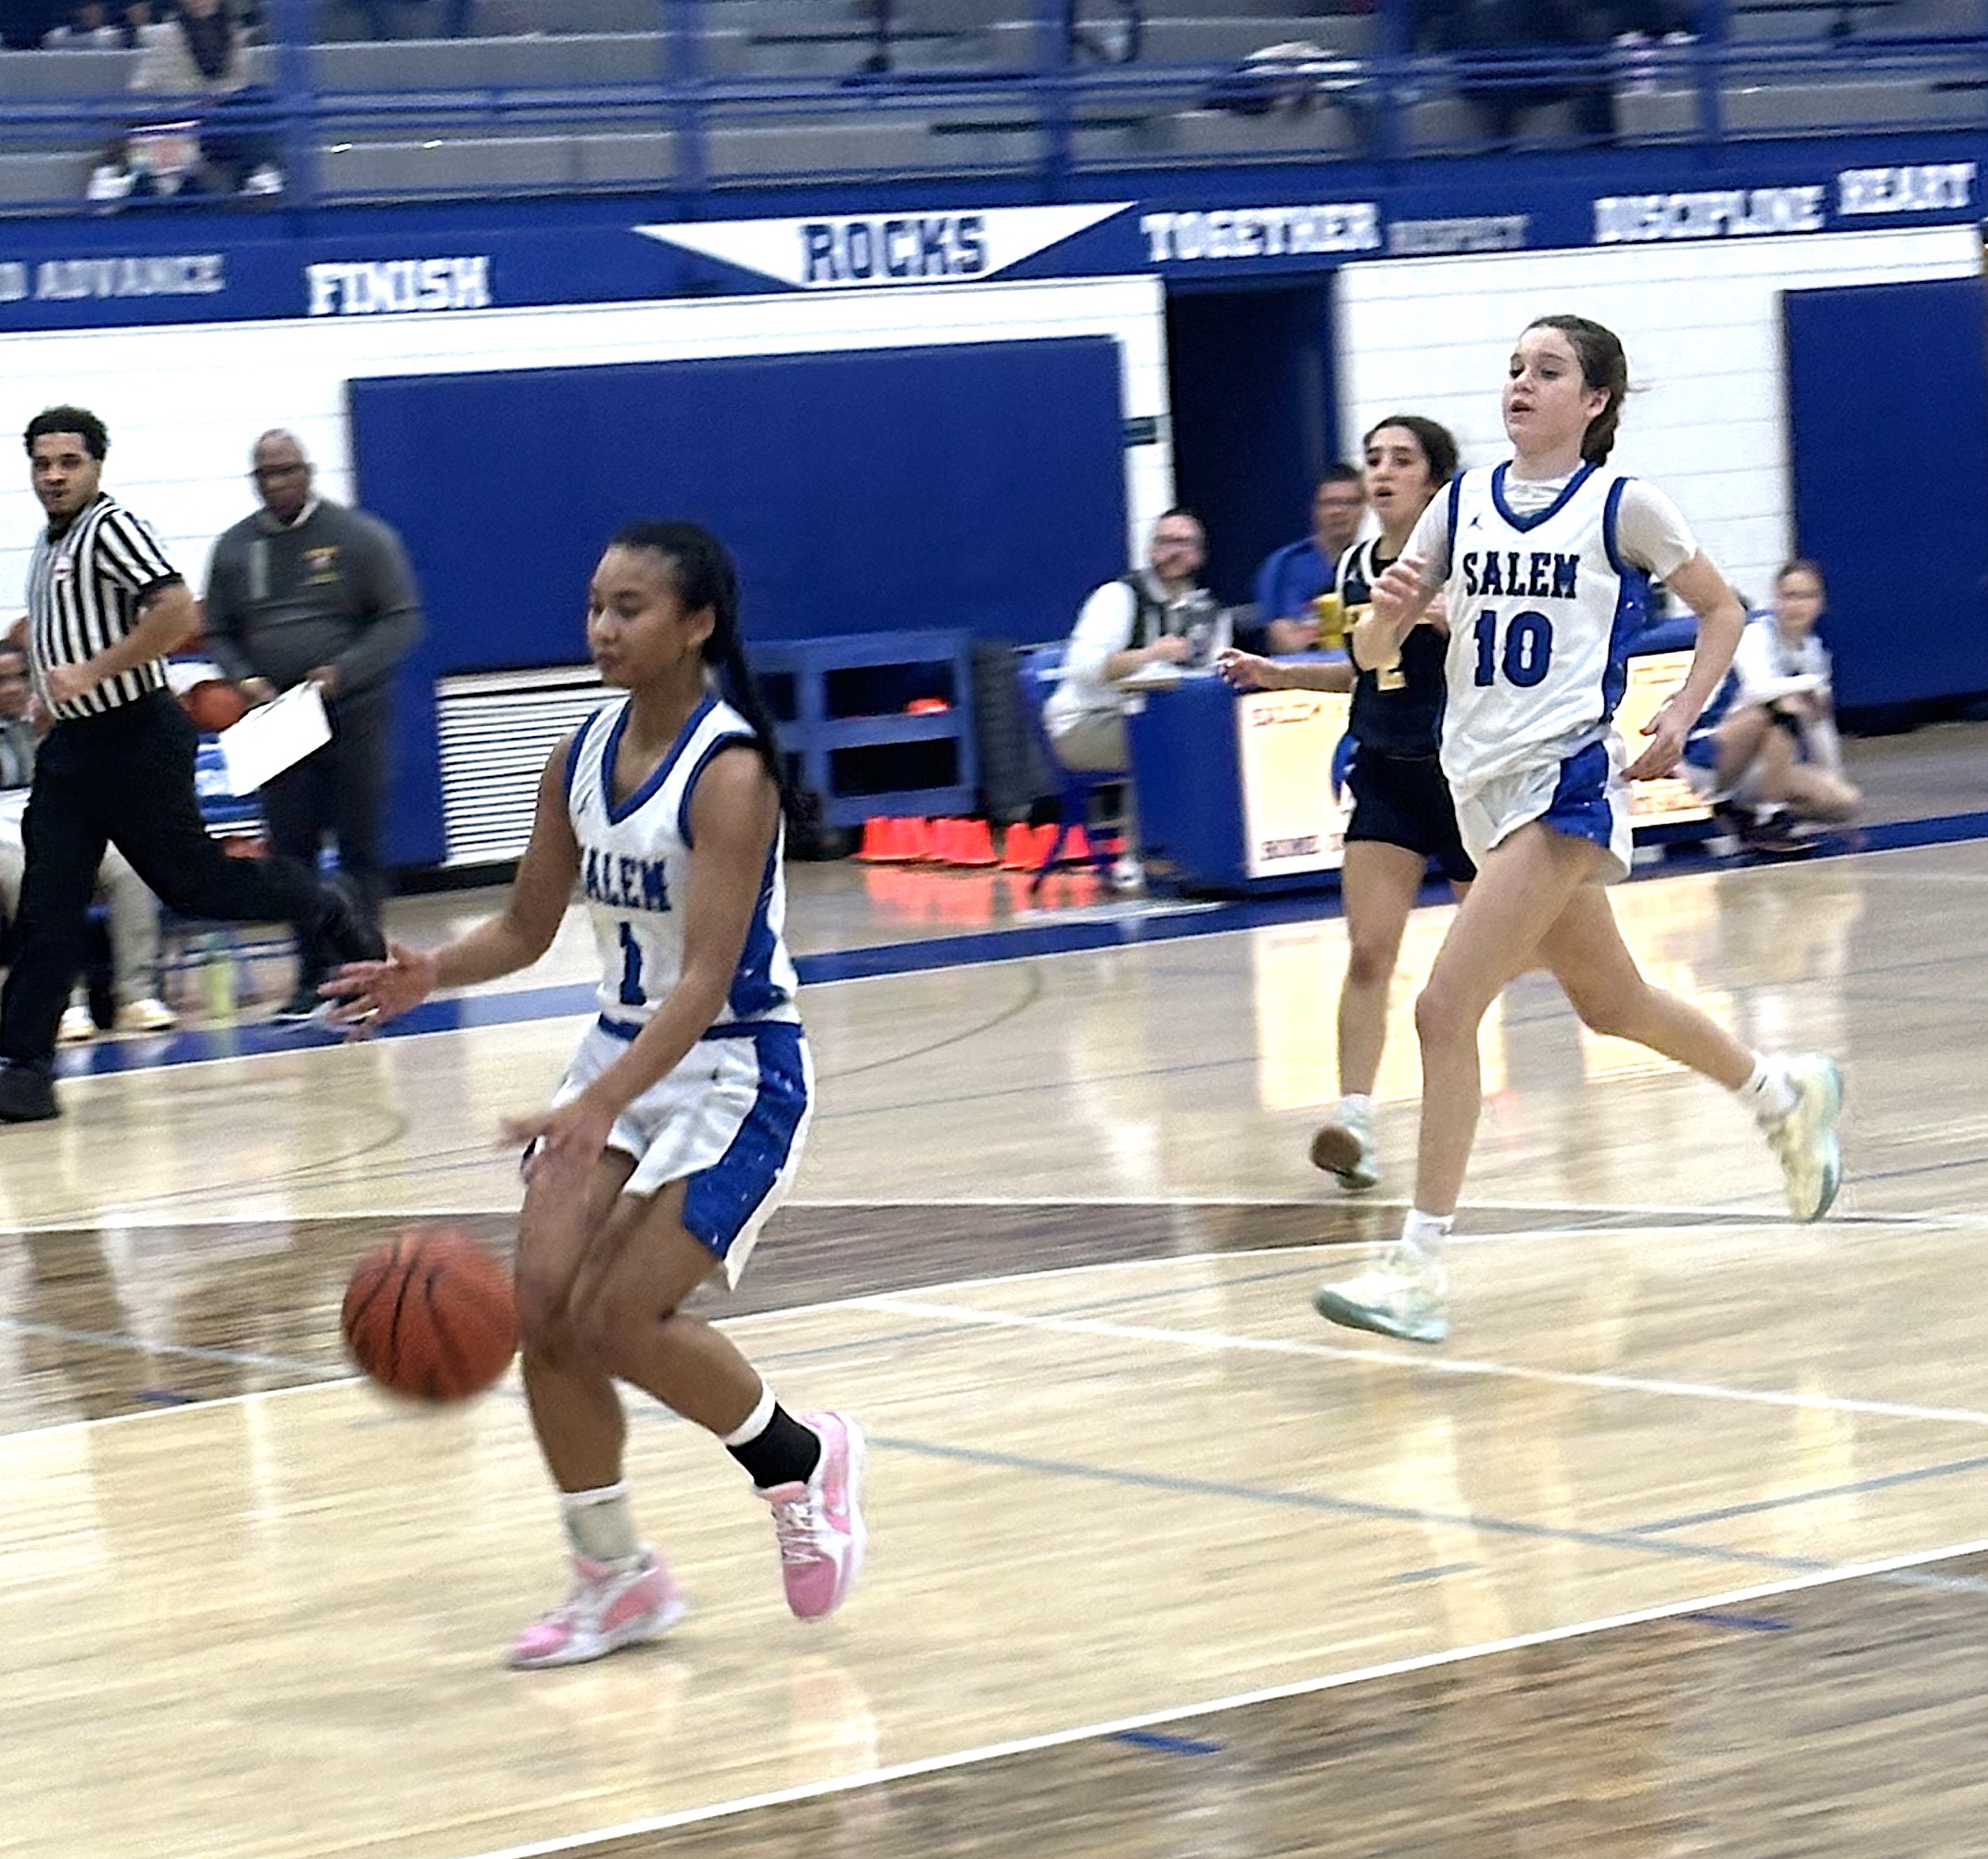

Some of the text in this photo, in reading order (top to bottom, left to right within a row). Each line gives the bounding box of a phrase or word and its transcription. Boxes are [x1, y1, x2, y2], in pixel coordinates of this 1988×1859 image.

[1141, 202, 1381, 261] TOGETHER
[1593, 185, 1825, 244] DISCIPLINE
[802, 217, 986, 280] ROCKS
[306, 256, 492, 315] FINISH
[1462, 551, 1580, 599] SALEM
[1473, 609, 1553, 687] 10
[578, 846, 671, 912] ALEM
[618, 921, 647, 1006] 1
